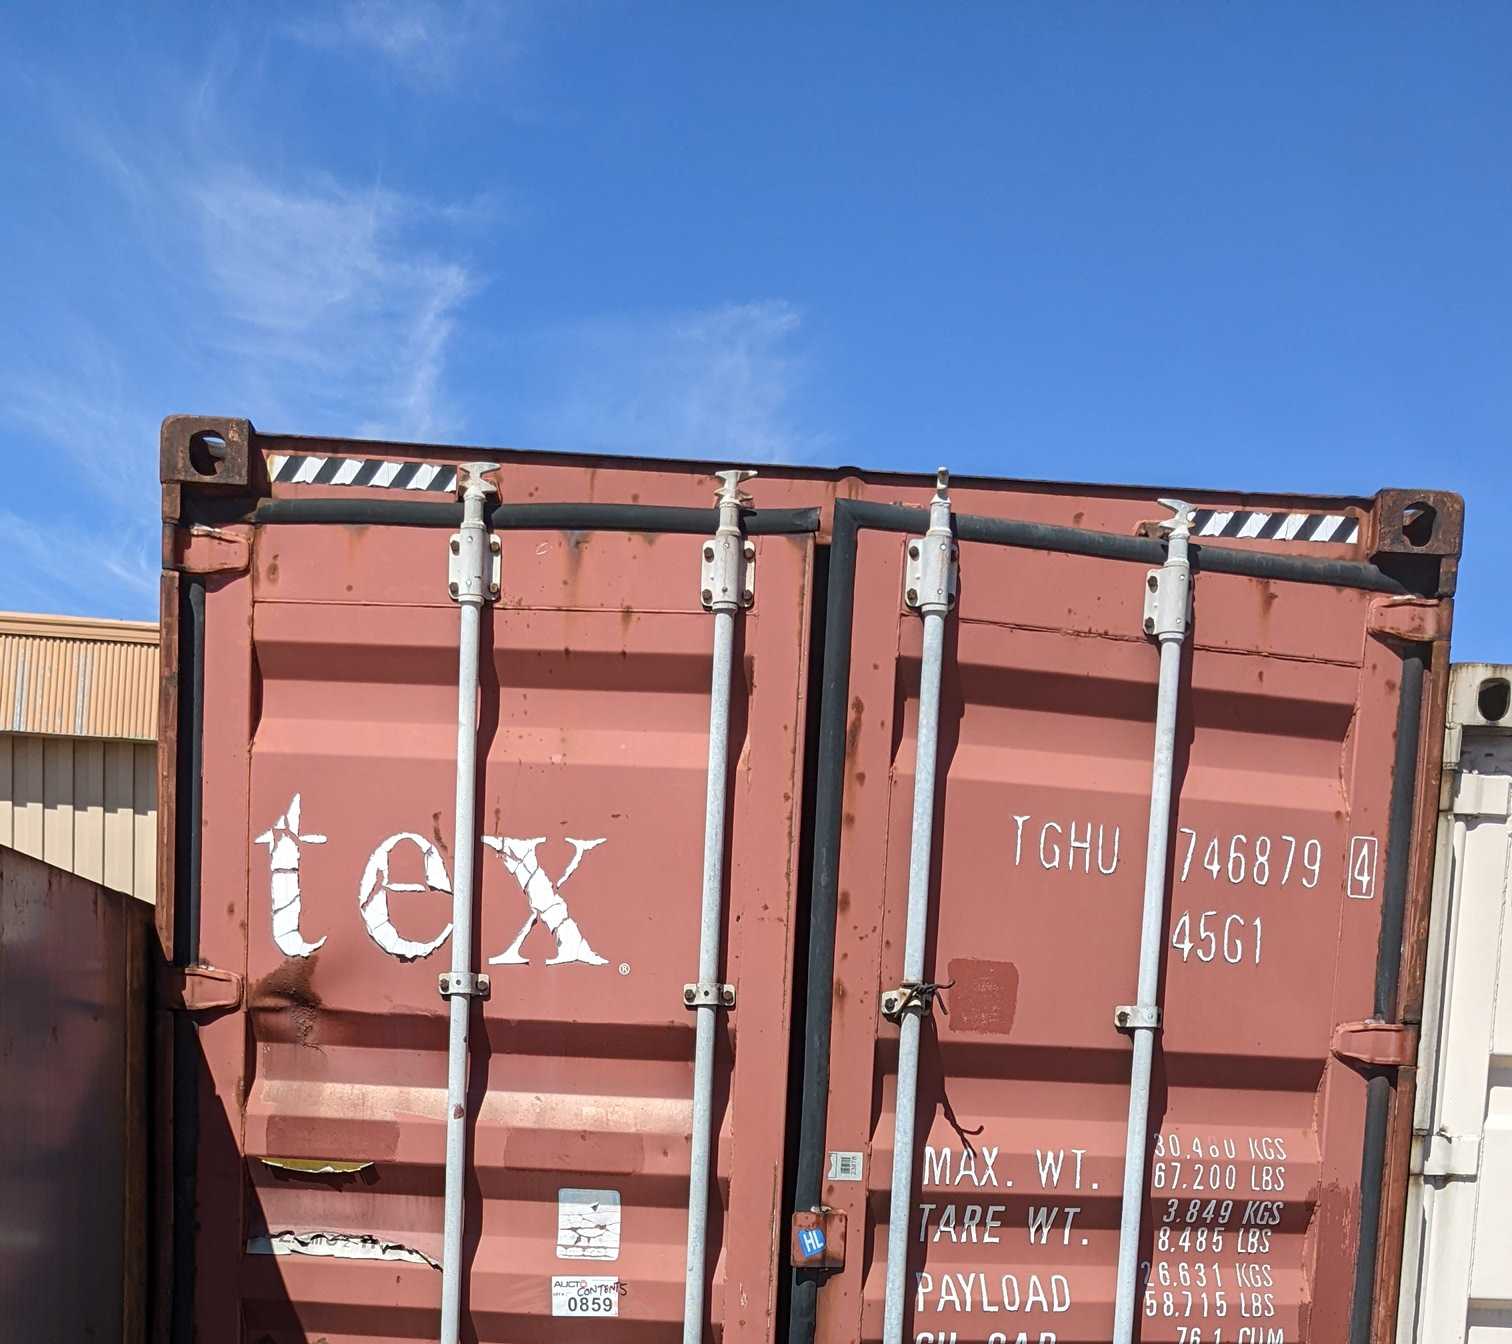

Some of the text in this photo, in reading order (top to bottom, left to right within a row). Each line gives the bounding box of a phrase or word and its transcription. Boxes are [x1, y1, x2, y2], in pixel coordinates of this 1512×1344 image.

[1012, 815, 1120, 875] TGHU
[1179, 828, 1321, 889] 746879
[254, 792, 609, 965] tex
[1172, 911, 1263, 964] 45G1
[1249, 1137, 1286, 1160] KGS
[923, 1147, 1098, 1189] MAX. WT.
[1251, 1165, 1285, 1191] LBS
[919, 1204, 1089, 1245] TARE WT.
[1242, 1201, 1284, 1225] KGS
[1237, 1228, 1272, 1254] LBS
[1235, 1263, 1273, 1288] KGS
[568, 1297, 612, 1312] 0859
[916, 1272, 1071, 1312] PAYLOAD
[1240, 1292, 1275, 1317] LBS
